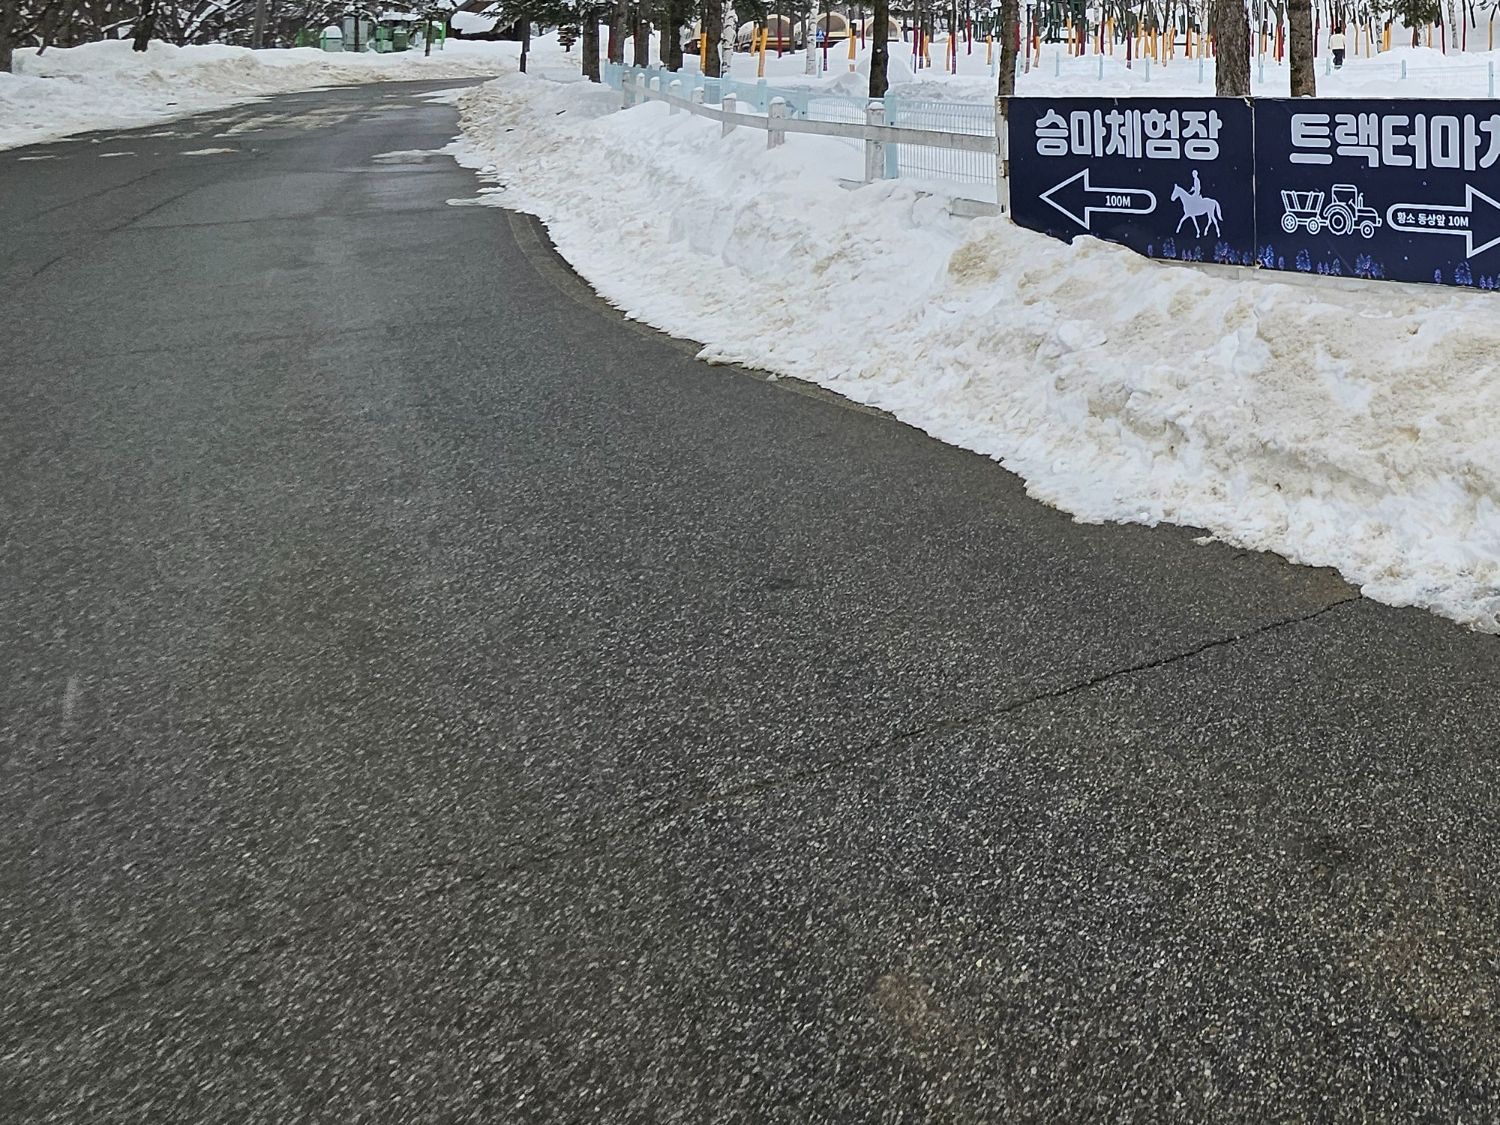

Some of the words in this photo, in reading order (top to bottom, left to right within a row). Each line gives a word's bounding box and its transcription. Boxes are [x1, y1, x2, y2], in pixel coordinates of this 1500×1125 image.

[1035, 108, 1223, 161] 승마체험장
[1105, 195, 1131, 207] 100M
[1397, 211, 1416, 224] 황소
[1418, 213, 1445, 227] 동상앞
[1448, 216, 1469, 227] 10M
